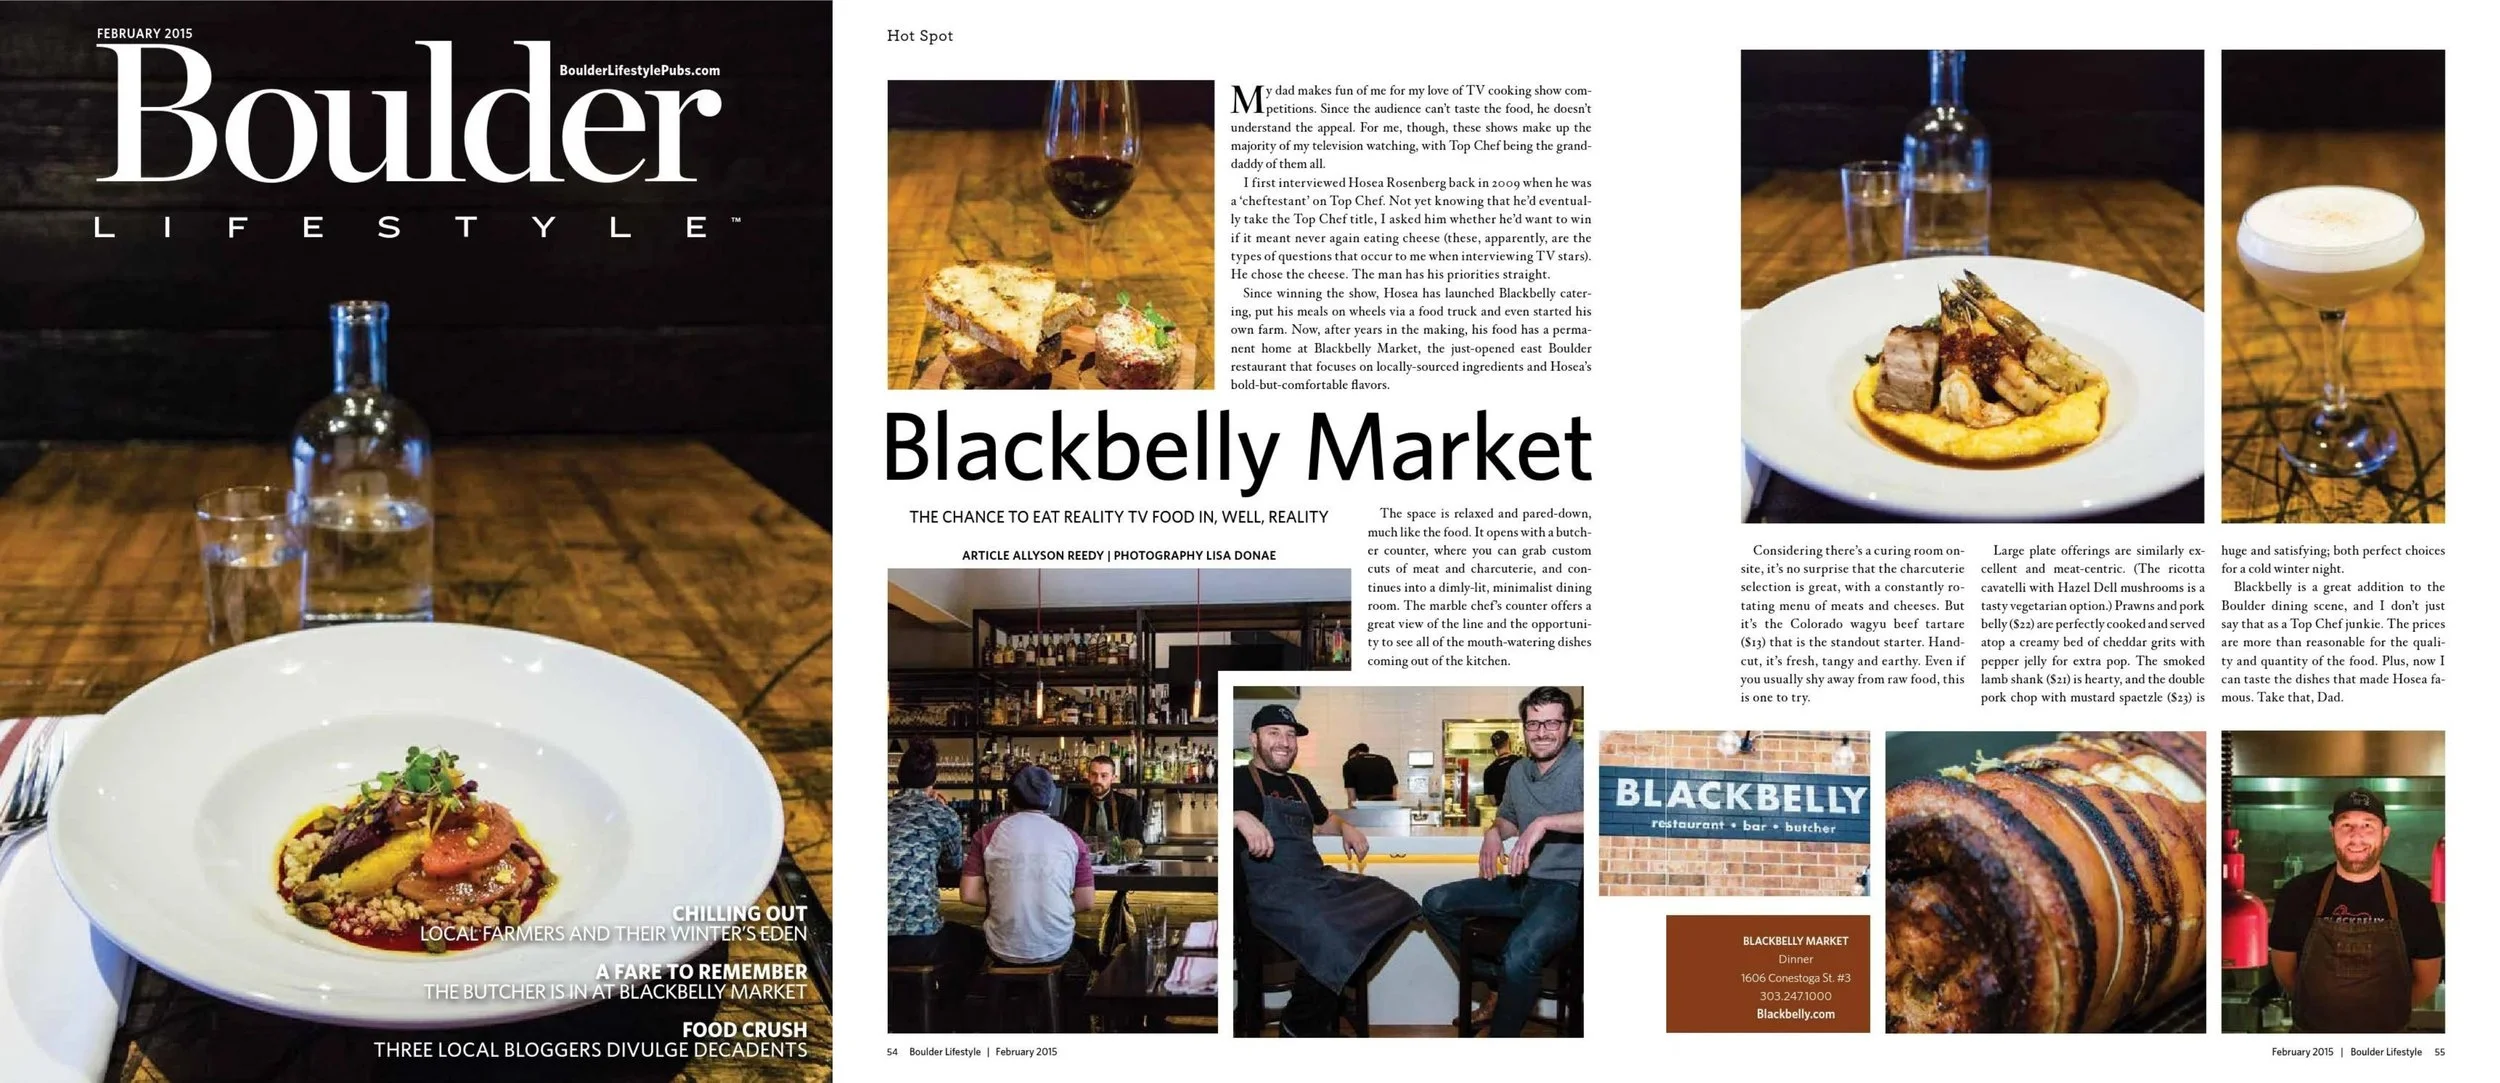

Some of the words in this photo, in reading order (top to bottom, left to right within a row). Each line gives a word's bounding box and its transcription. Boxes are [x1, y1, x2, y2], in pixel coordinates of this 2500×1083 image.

[98, 29, 160, 38] FEBRUARY
[165, 29, 192, 38] 2015
[887, 29, 914, 41] Hot
[919, 29, 953, 45] Spot
[560, 65, 720, 78] BoulderLifestylePubs.com
[96, 41, 722, 183] Boulder
[1243, 176, 1248, 187] I
[1251, 176, 1275, 187] first
[1278, 176, 1345, 187] interviewed
[1348, 176, 1384, 187] Hosea
[1386, 176, 1446, 191] Rosenberg
[1448, 176, 1475, 187] back
[1477, 177, 1489, 187] in
[1491, 180, 1520, 190] 2009
[1522, 176, 1552, 187] when
[1555, 176, 1568, 187] he
[95, 216, 706, 238] LIFESTYLE
[1230, 344, 1255, 353] nent
[1261, 342, 1291, 353] home
[1297, 344, 1307, 353] at
[1314, 342, 1371, 356] Blackbelly
[1376, 342, 1421, 355] Market,
[1427, 342, 1444, 353] the
[1450, 342, 1514, 357] just-opened
[1520, 344, 1542, 353] east
[1548, 342, 1592, 353] Boulder
[1230, 363, 1286, 371] restaurant
[1289, 360, 1312, 371] that
[1316, 360, 1356, 371] focuses
[1376, 360, 1459, 375] locally-sourced
[1462, 360, 1523, 375] ingredients
[1526, 360, 1547, 371] and
[1230, 378, 1348, 389] bold-but-comfortable
[1351, 378, 1389, 389] flavors.
[887, 409, 1280, 498] Blackbelly
[1308, 410, 1592, 481] Market
[908, 509, 938, 523] THE
[942, 510, 1004, 523] CHANCE
[1007, 510, 1029, 523] TO
[1033, 509, 1060, 523] EAT
[1064, 509, 1124, 523] REALITY
[1127, 509, 1148, 523] TV
[1152, 509, 1194, 523] FOOD
[1199, 510, 1217, 525] IN,
[1221, 510, 1264, 525] WELL,
[1268, 509, 1328, 523] REALITY
[1379, 507, 1402, 518] The
[1406, 510, 1436, 522] space
[1440, 508, 1449, 518] is
[1454, 507, 1493, 518] relaxed
[1497, 507, 1518, 518] and
[1522, 507, 1591, 521] pared-down,
[961, 550, 1009, 560] ARTICLE
[1012, 550, 1064, 560] ALLYSON
[1067, 550, 1104, 560] REEDY
[1113, 550, 1203, 560] PHOTOGRAPHY
[1206, 550, 1231, 560] LISA
[1234, 550, 1276, 560] DONAE
[1752, 544, 1823, 559] Considering
[1873, 545, 1911, 559] curing
[1993, 544, 2024, 559] Large
[2029, 544, 2056, 559] plate
[2060, 544, 2110, 559] offerings
[2136, 544, 2184, 558] similarly
[1367, 565, 1390, 573] cuts
[1395, 562, 1408, 573] of
[1412, 565, 1439, 573] meat
[1445, 562, 1465, 573] and
[1470, 562, 1536, 575] charcuterie,
[1541, 562, 1562, 573] and
[2221, 562, 2237, 573] for
[2248, 562, 2271, 573] cold
[2273, 563, 2309, 573] winter
[2312, 562, 2344, 577] night.
[1769, 636, 1792, 647] that
[1796, 636, 1805, 647] is
[1808, 636, 1827, 647] the
[1830, 636, 1880, 647] standout
[1883, 638, 1924, 647] starter.
[1928, 635, 1964, 647] Hand-
[1981, 673, 2008, 684] lamb
[2010, 673, 2043, 684] shank
[2073, 674, 2082, 684] is
[2084, 673, 2122, 687] hearty,
[2124, 673, 2145, 684] and
[2147, 673, 2165, 684] the
[2168, 673, 2204, 684] double
[2221, 694, 2253, 702] mous.
[2256, 691, 2284, 702] Take
[2287, 691, 2314, 703] that,
[2317, 691, 2343, 702] Dad.
[1616, 777, 1867, 814] BLACKBELLY
[1651, 818, 1725, 830] restaurant
[1743, 820, 1767, 832] bar
[1785, 821, 1836, 834] butcher
[673, 906, 761, 921] CHILLING
[766, 906, 807, 921] OUT
[421, 926, 479, 942] LOCAL
[484, 926, 565, 942] FARMERS
[569, 926, 610, 942] AND
[614, 926, 666, 942] THEIR
[760, 926, 807, 942] EDEN
[1743, 936, 1803, 945] BLACKBELLY
[1805, 936, 1848, 945] MARKET
[1778, 954, 1813, 963] Dinner
[596, 964, 609, 980] A
[615, 964, 662, 980] FARE
[667, 964, 694, 980] TO
[699, 964, 807, 980] REMEMBER
[1741, 972, 1766, 982] 1606
[1768, 973, 1820, 984] Conestoga
[1822, 972, 1834, 982] St.
[1837, 973, 1851, 982] #3
[424, 984, 458, 1000] THE
[463, 984, 545, 1000] BUTCHER
[550, 984, 564, 1000] IS
[570, 984, 587, 1000] IN
[592, 984, 616, 1000] AT
[620, 984, 726, 1000] BLACKBELLY
[730, 984, 807, 1000] MARKET
[1757, 1008, 1835, 1020] Blackbelly.com
[683, 1023, 737, 1038] FOOD
[742, 1023, 807, 1038] CRUSH
[374, 1043, 432, 1057] THREE
[440, 1043, 498, 1057] LOCAL
[506, 1043, 600, 1057] BLOGGERS
[608, 1043, 688, 1057] DIVULGE
[695, 1043, 807, 1057] DECADENTS
[886, 1047, 898, 1056] 54
[909, 1046, 943, 1056] Boulder
[944, 1047, 981, 1058] Lifestyle
[995, 1047, 1034, 1058] February
[1035, 1046, 1057, 1056] 2015
[2271, 1047, 2310, 1058] February
[2312, 1047, 2333, 1056] 2015
[2350, 1047, 2384, 1056] Boulder
[2386, 1047, 2422, 1058] Lifestyle
[2434, 1047, 2445, 1056] 55
